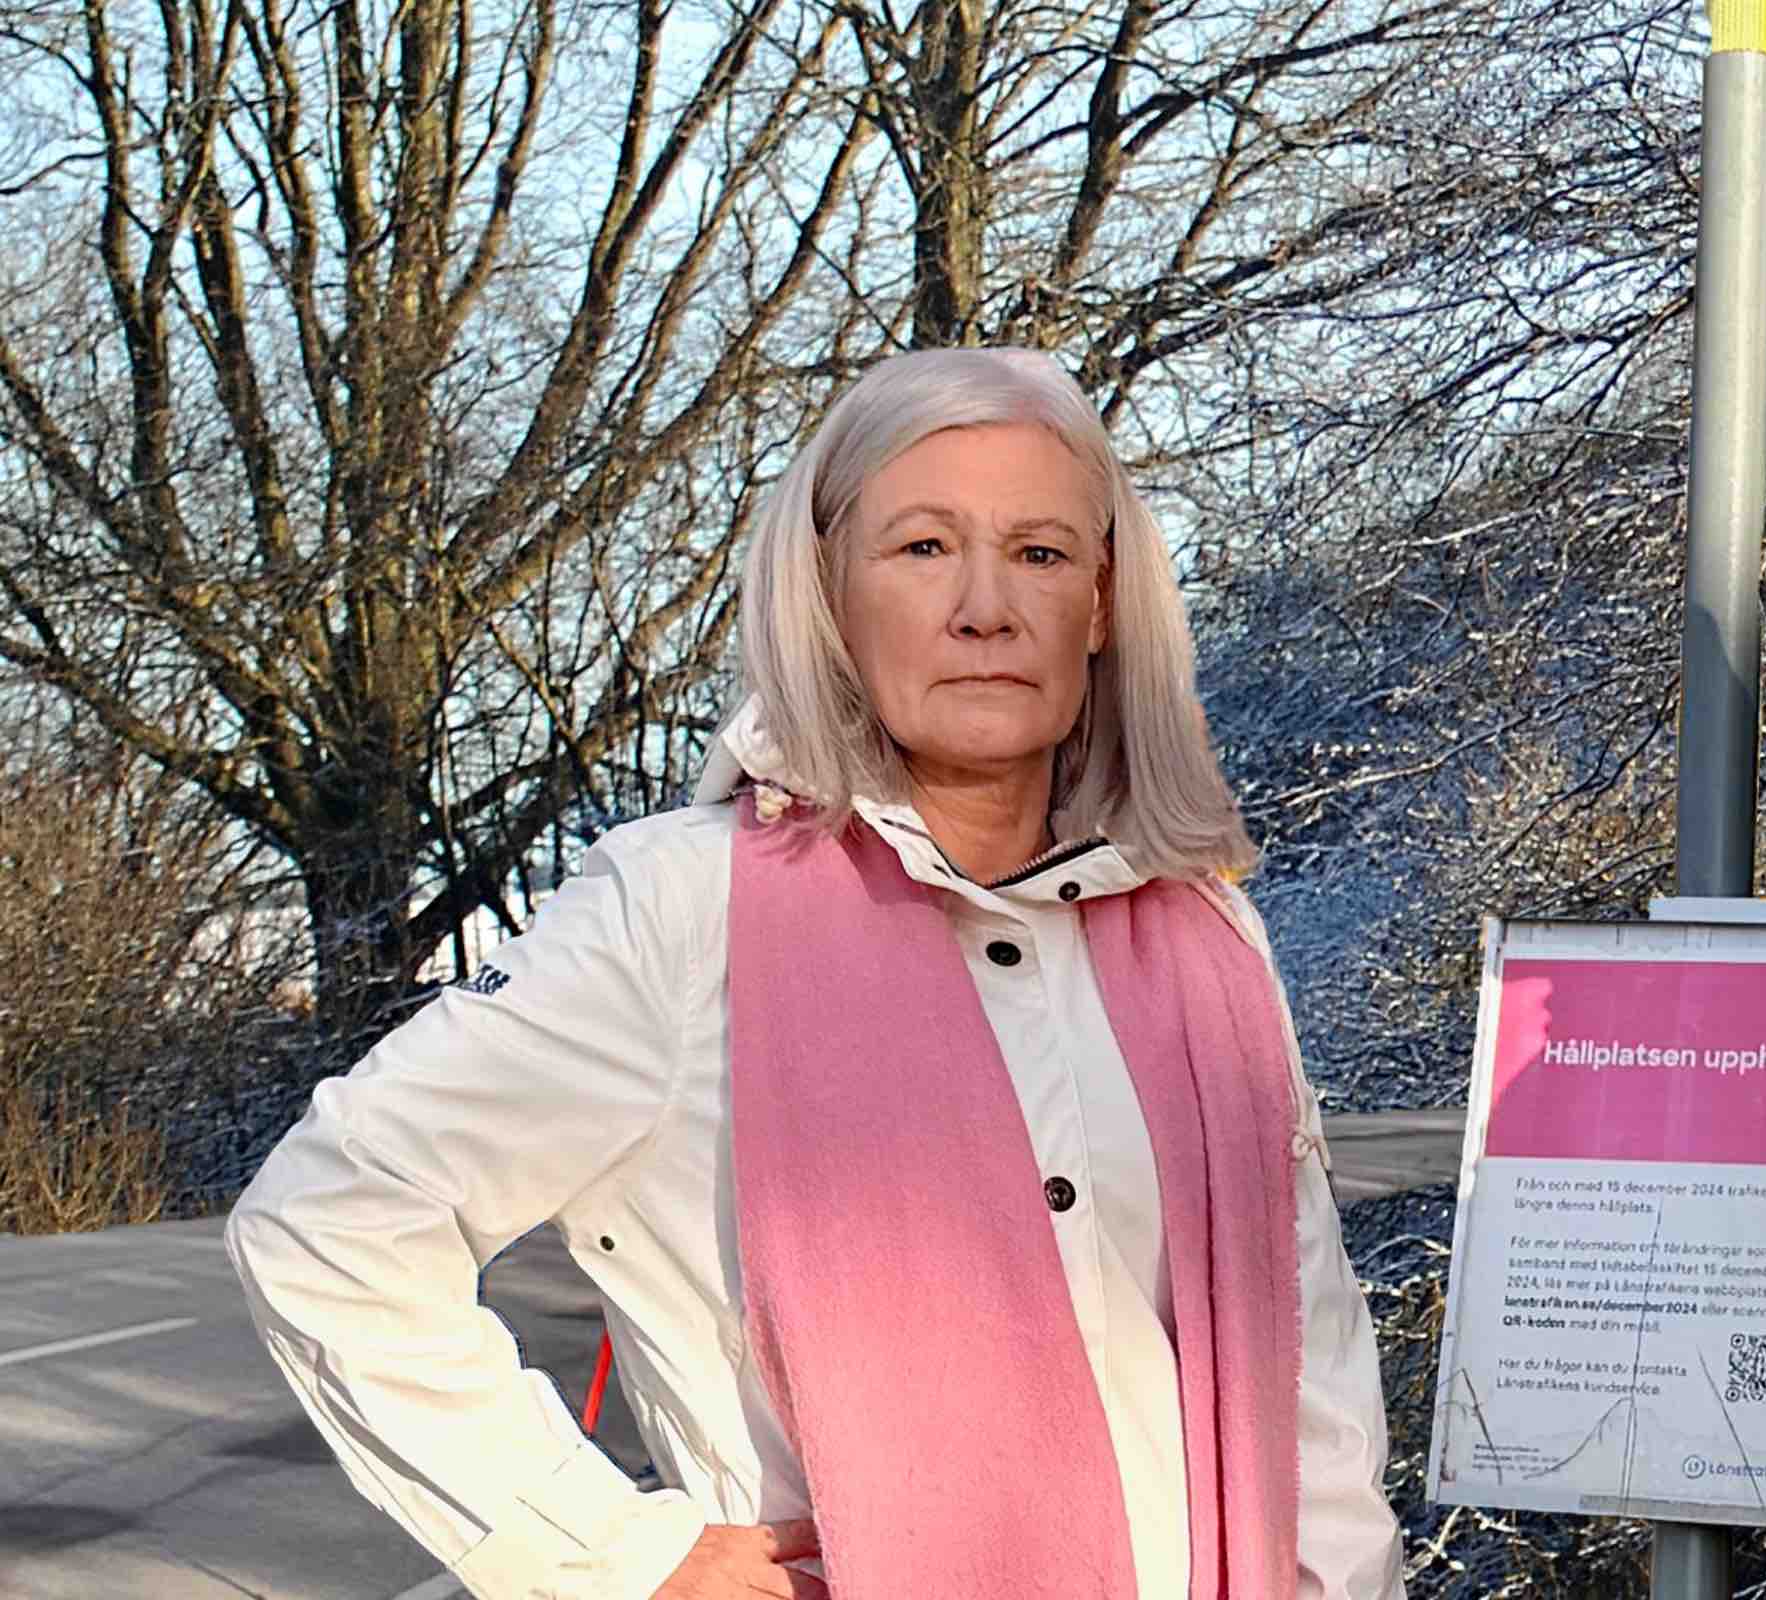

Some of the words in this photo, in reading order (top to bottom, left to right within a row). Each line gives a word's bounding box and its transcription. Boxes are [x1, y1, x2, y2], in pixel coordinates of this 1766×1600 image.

[1543, 1038, 1696, 1072] Hållplatsen
[1515, 1177, 1545, 1192] Från
[1549, 1180, 1571, 1192] och
[1574, 1180, 1603, 1193] med
[1607, 1181, 1620, 1193] 15
[1623, 1181, 1687, 1196] december
[1691, 1183, 1724, 1197] 2024
[1513, 1198, 1553, 1213] längre
[1556, 1199, 1596, 1212] denna
[1510, 1235, 1531, 1249] För
[1534, 1238, 1560, 1250] mer
[1563, 1239, 1637, 1252] information
[1663, 1242, 1743, 1260] förändringar
[1508, 1256, 1566, 1271] samband
[1569, 1258, 1598, 1272] med
[1704, 1263, 1717, 1277] 15
[1544, 1275, 1562, 1290] läs
[1566, 1277, 1592, 1291] mer
[1595, 1278, 1611, 1294] på
[1614, 1278, 1700, 1296] Länstrafikens
[1702, 1300, 1729, 1315] eller
[1502, 1314, 1566, 1330] QR-koden
[1569, 1317, 1598, 1332] med
[1600, 1319, 1621, 1333] din
[1499, 1356, 1521, 1370] Har
[1523, 1358, 1541, 1371] du
[1544, 1357, 1583, 1375] frågor
[1585, 1362, 1609, 1373] kan
[1611, 1363, 1629, 1375] du
[1496, 1376, 1581, 1394] Länstrafikens
